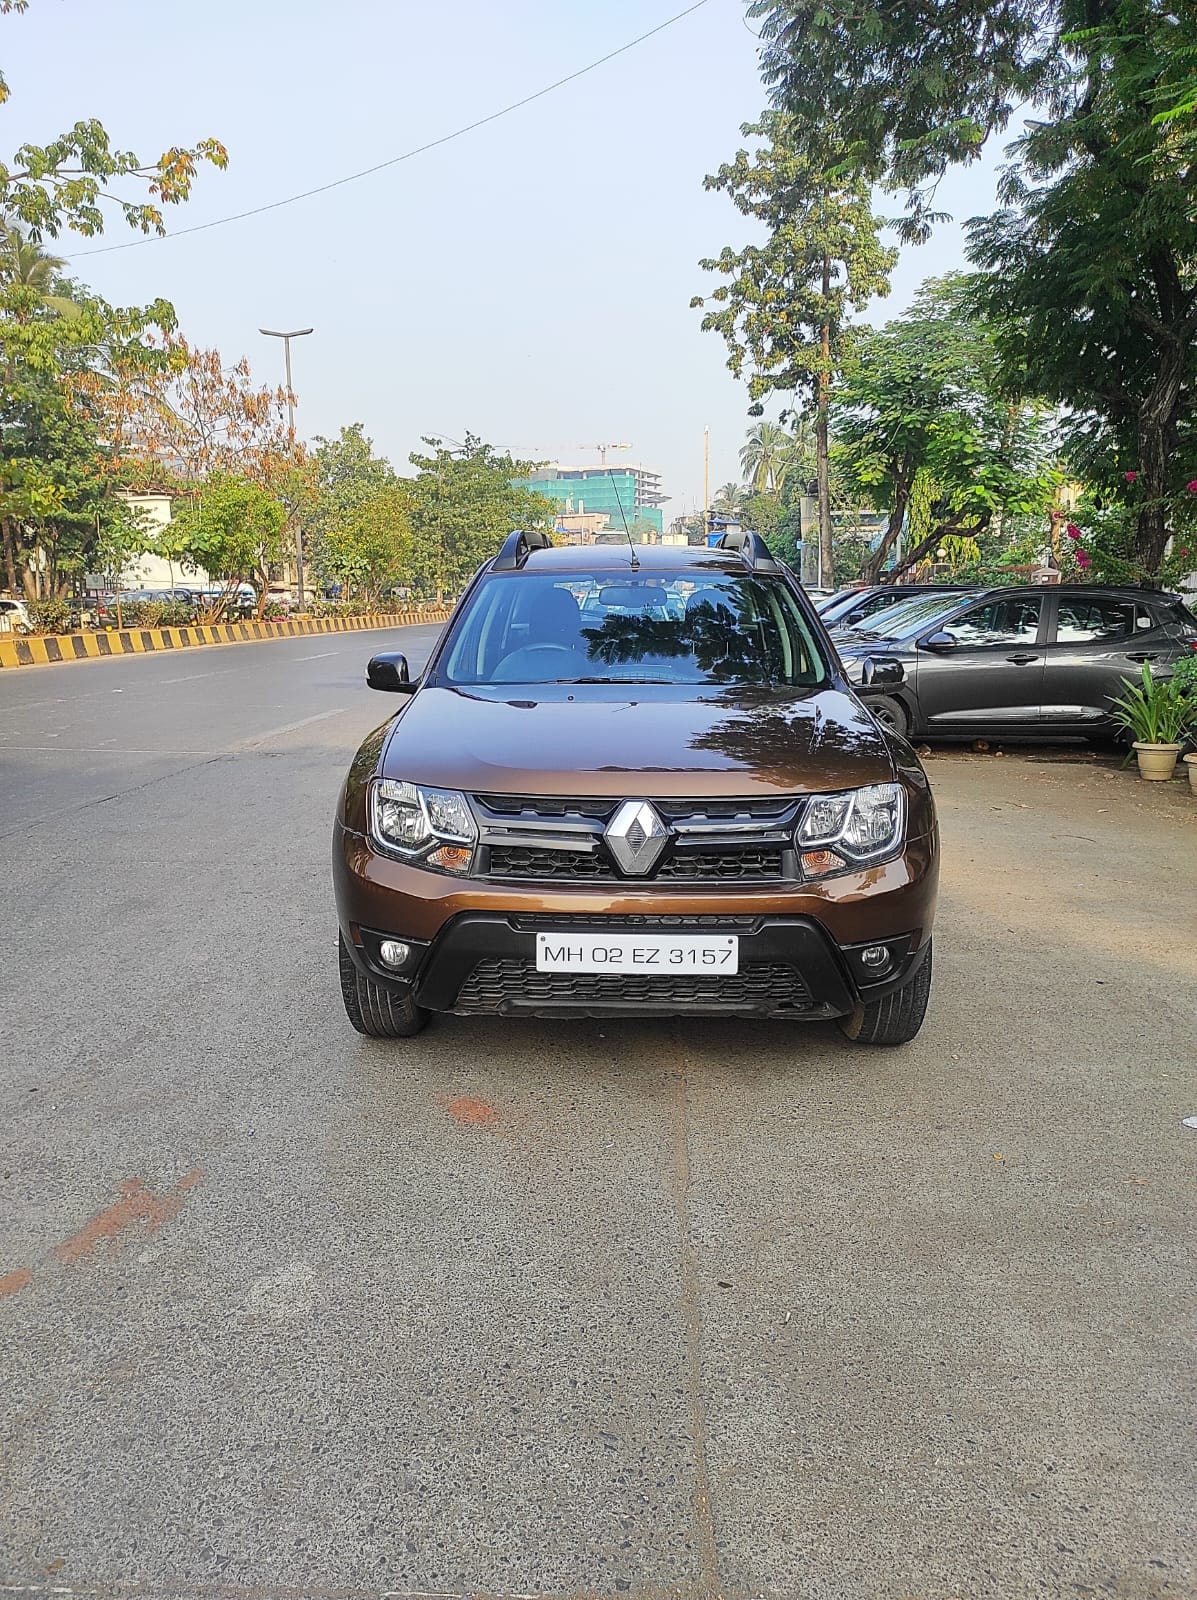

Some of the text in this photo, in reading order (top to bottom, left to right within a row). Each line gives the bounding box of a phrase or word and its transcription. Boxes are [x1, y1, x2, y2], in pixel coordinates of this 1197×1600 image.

[544, 946, 733, 965] MH 02 EZ 3157
